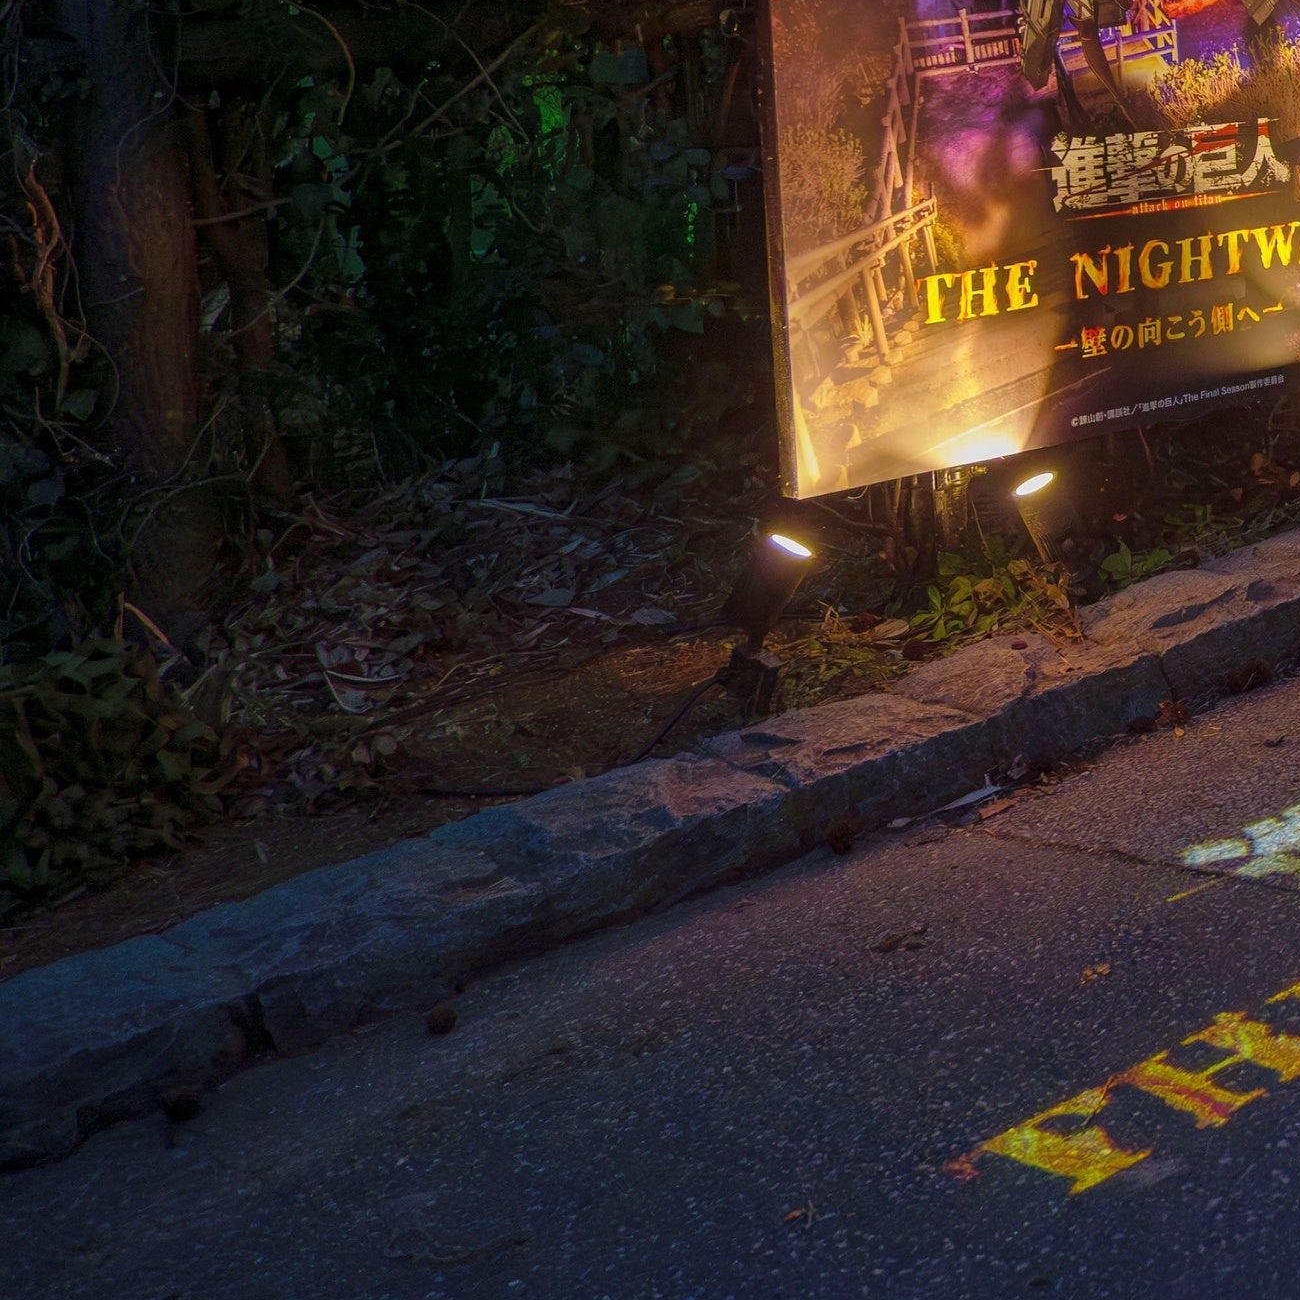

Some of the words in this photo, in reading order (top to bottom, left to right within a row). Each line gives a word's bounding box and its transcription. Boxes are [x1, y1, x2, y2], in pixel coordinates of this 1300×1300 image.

[1050, 117, 1292, 213] 進撃の巨人
[916, 259, 1040, 325] THE
